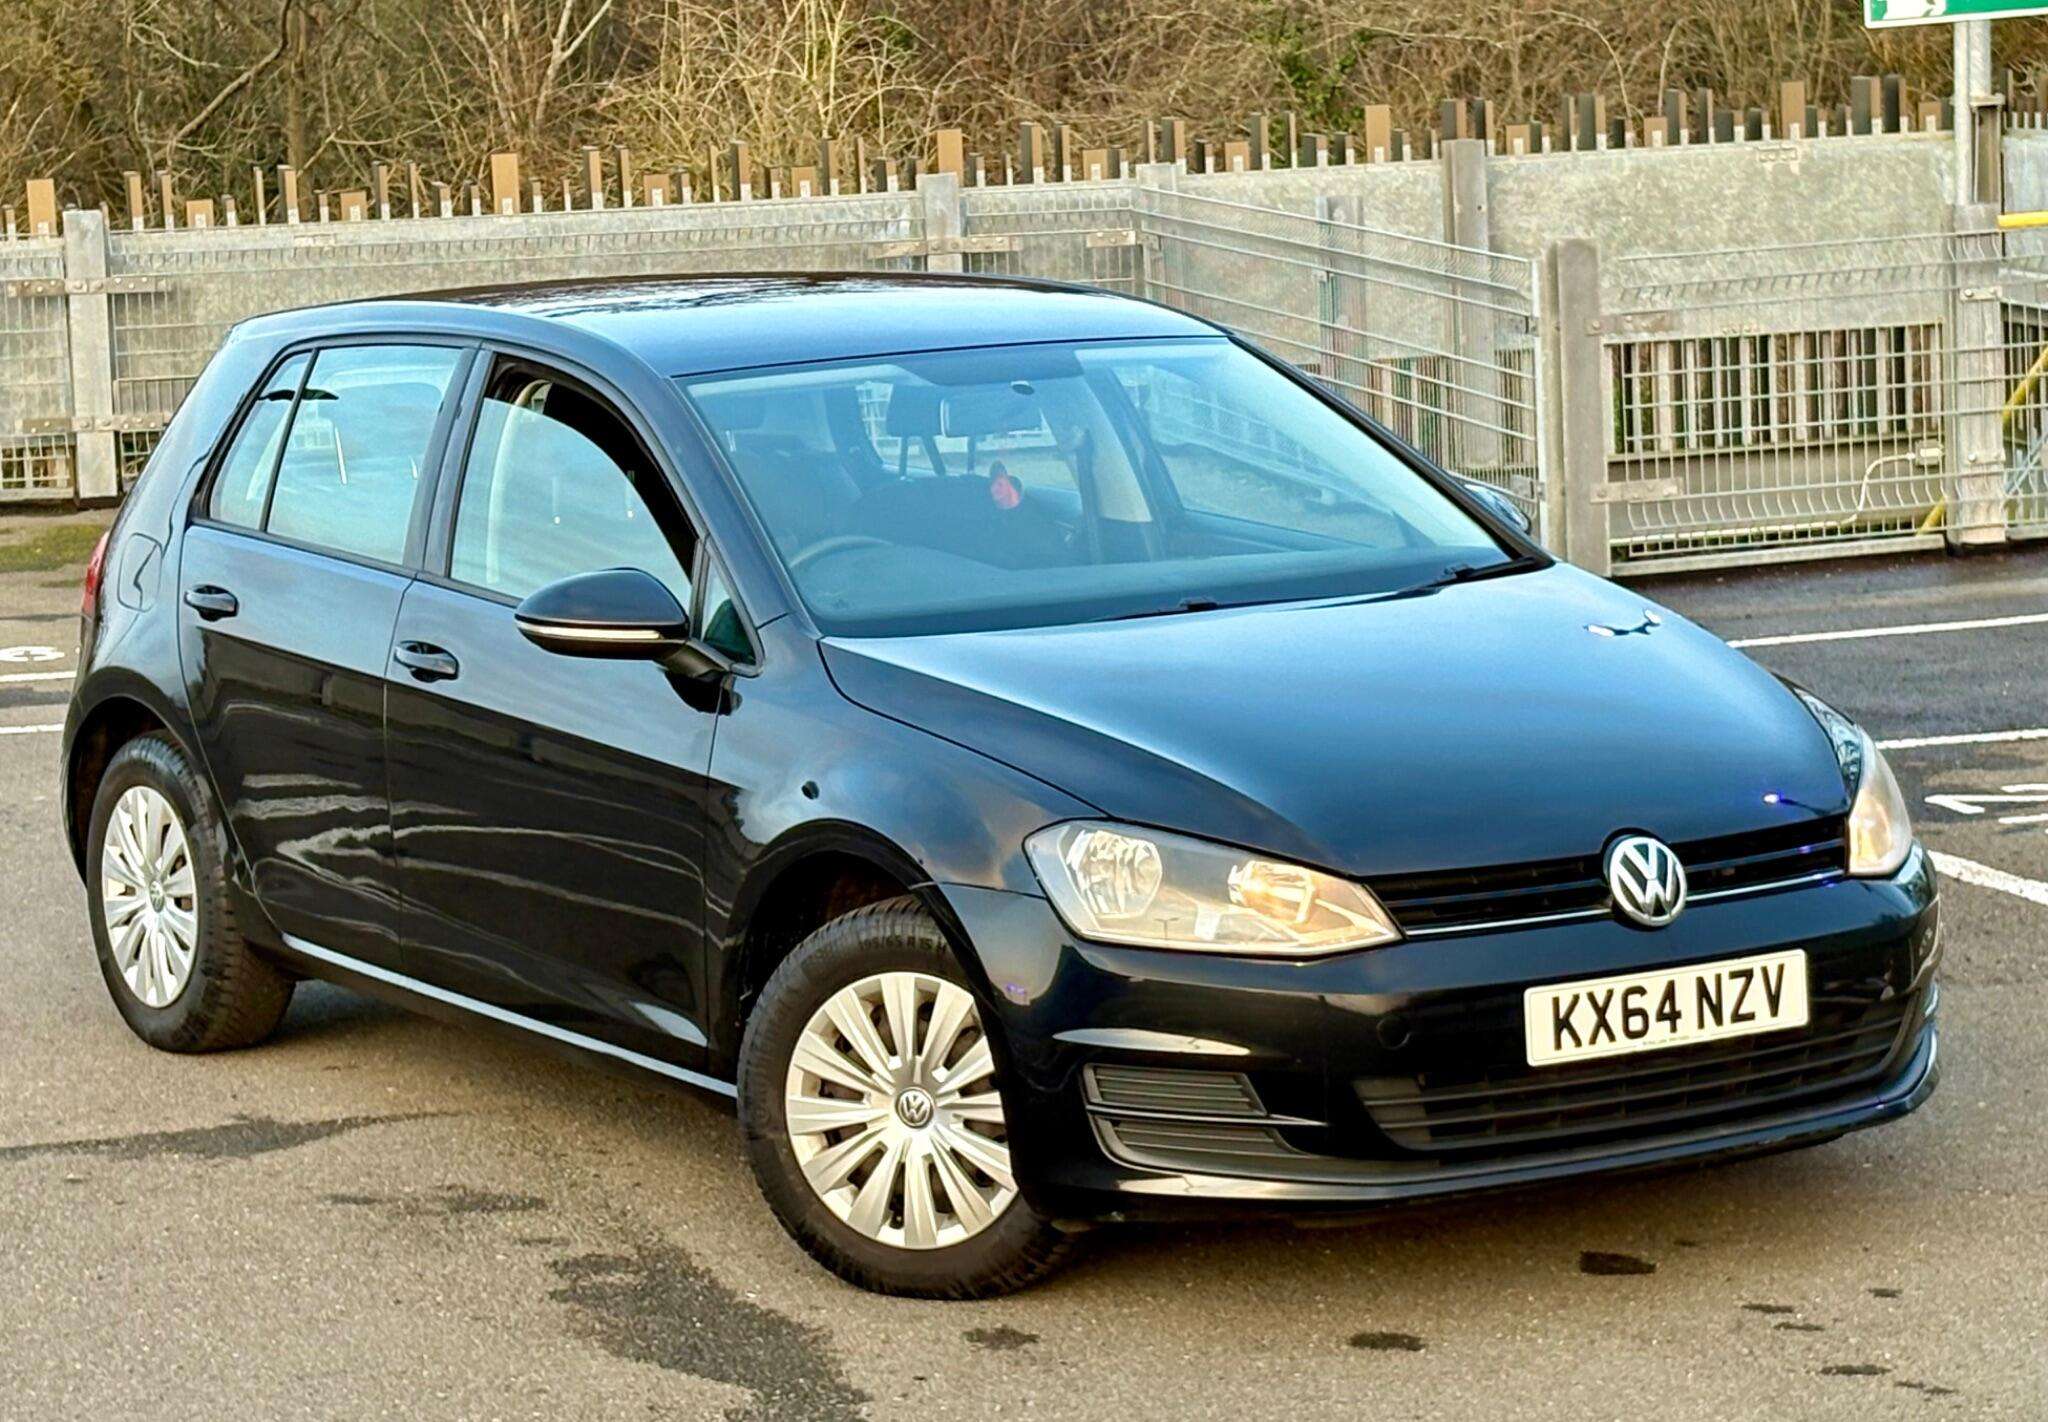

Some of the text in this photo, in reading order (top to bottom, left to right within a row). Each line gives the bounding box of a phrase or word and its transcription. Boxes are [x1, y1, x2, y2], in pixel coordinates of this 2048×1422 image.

[1610, 837, 1686, 924] VW
[1552, 963, 1785, 1051] KX64 NZV
[900, 1089, 932, 1126] VW
